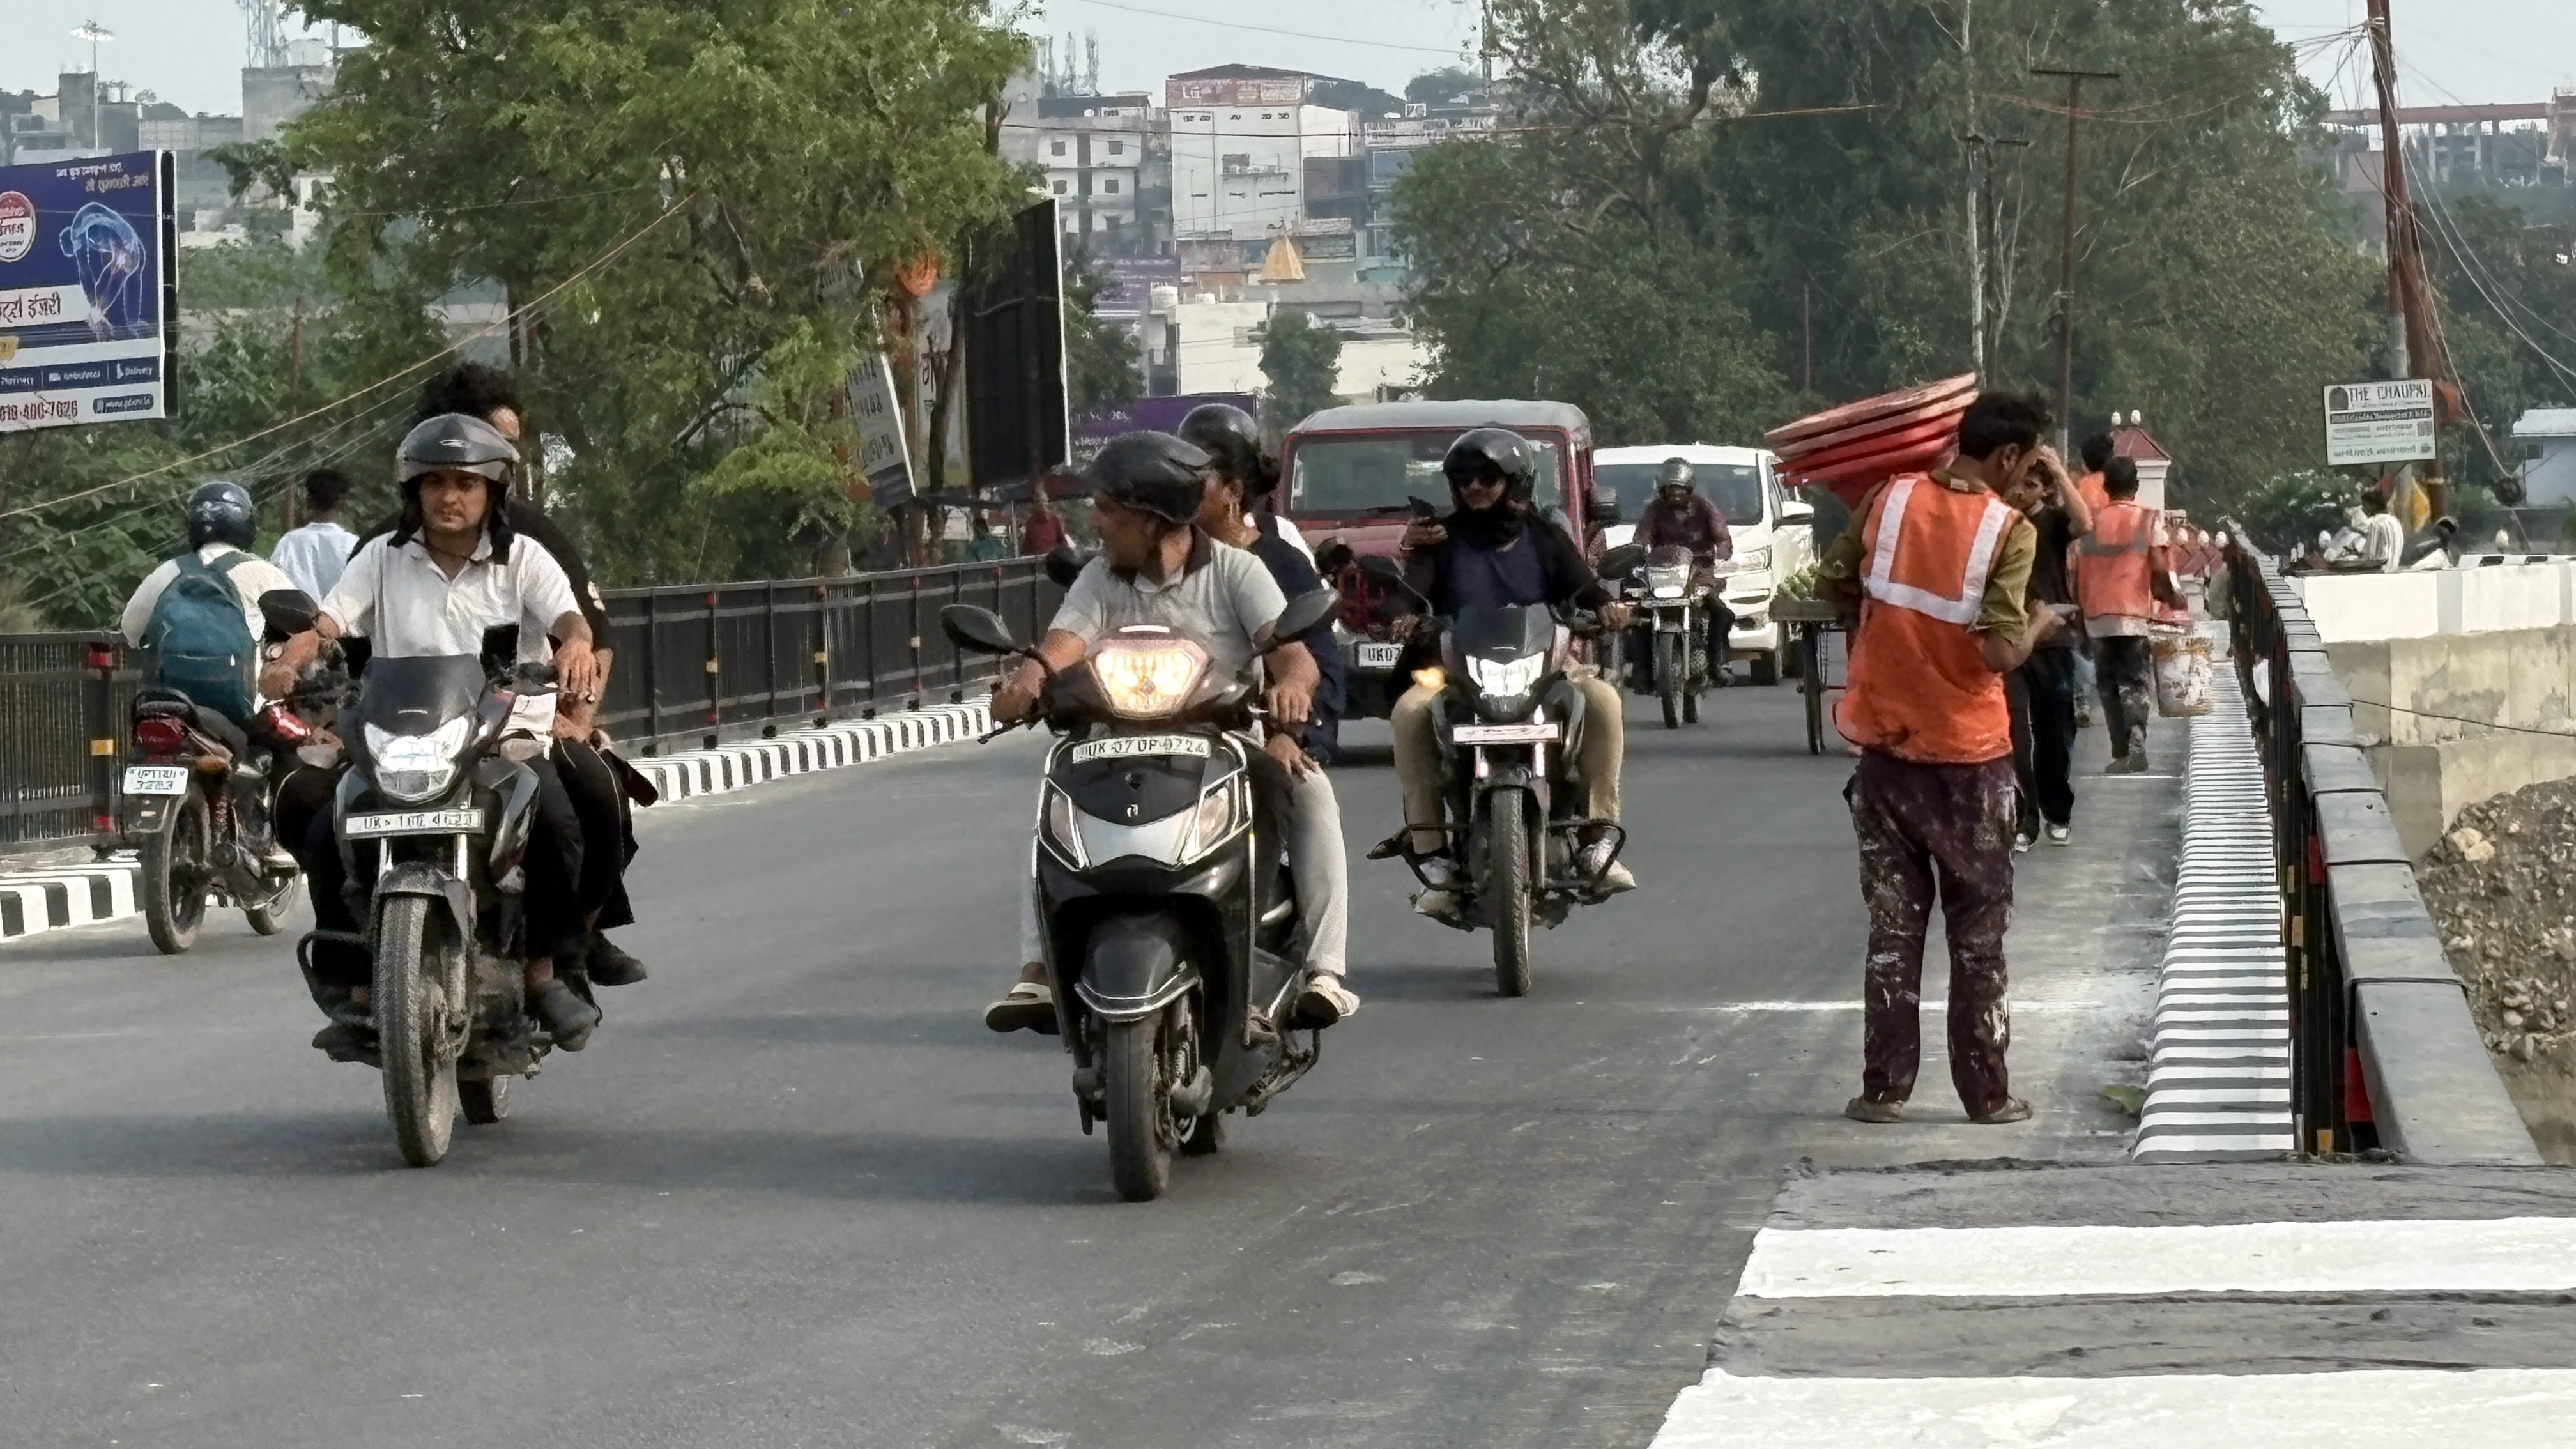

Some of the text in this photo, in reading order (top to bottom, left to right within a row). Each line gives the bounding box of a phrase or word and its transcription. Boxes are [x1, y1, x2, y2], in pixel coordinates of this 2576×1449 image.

[1182, 85, 1200, 99] LG
[2349, 383, 2430, 401] THE CHAUPAL
